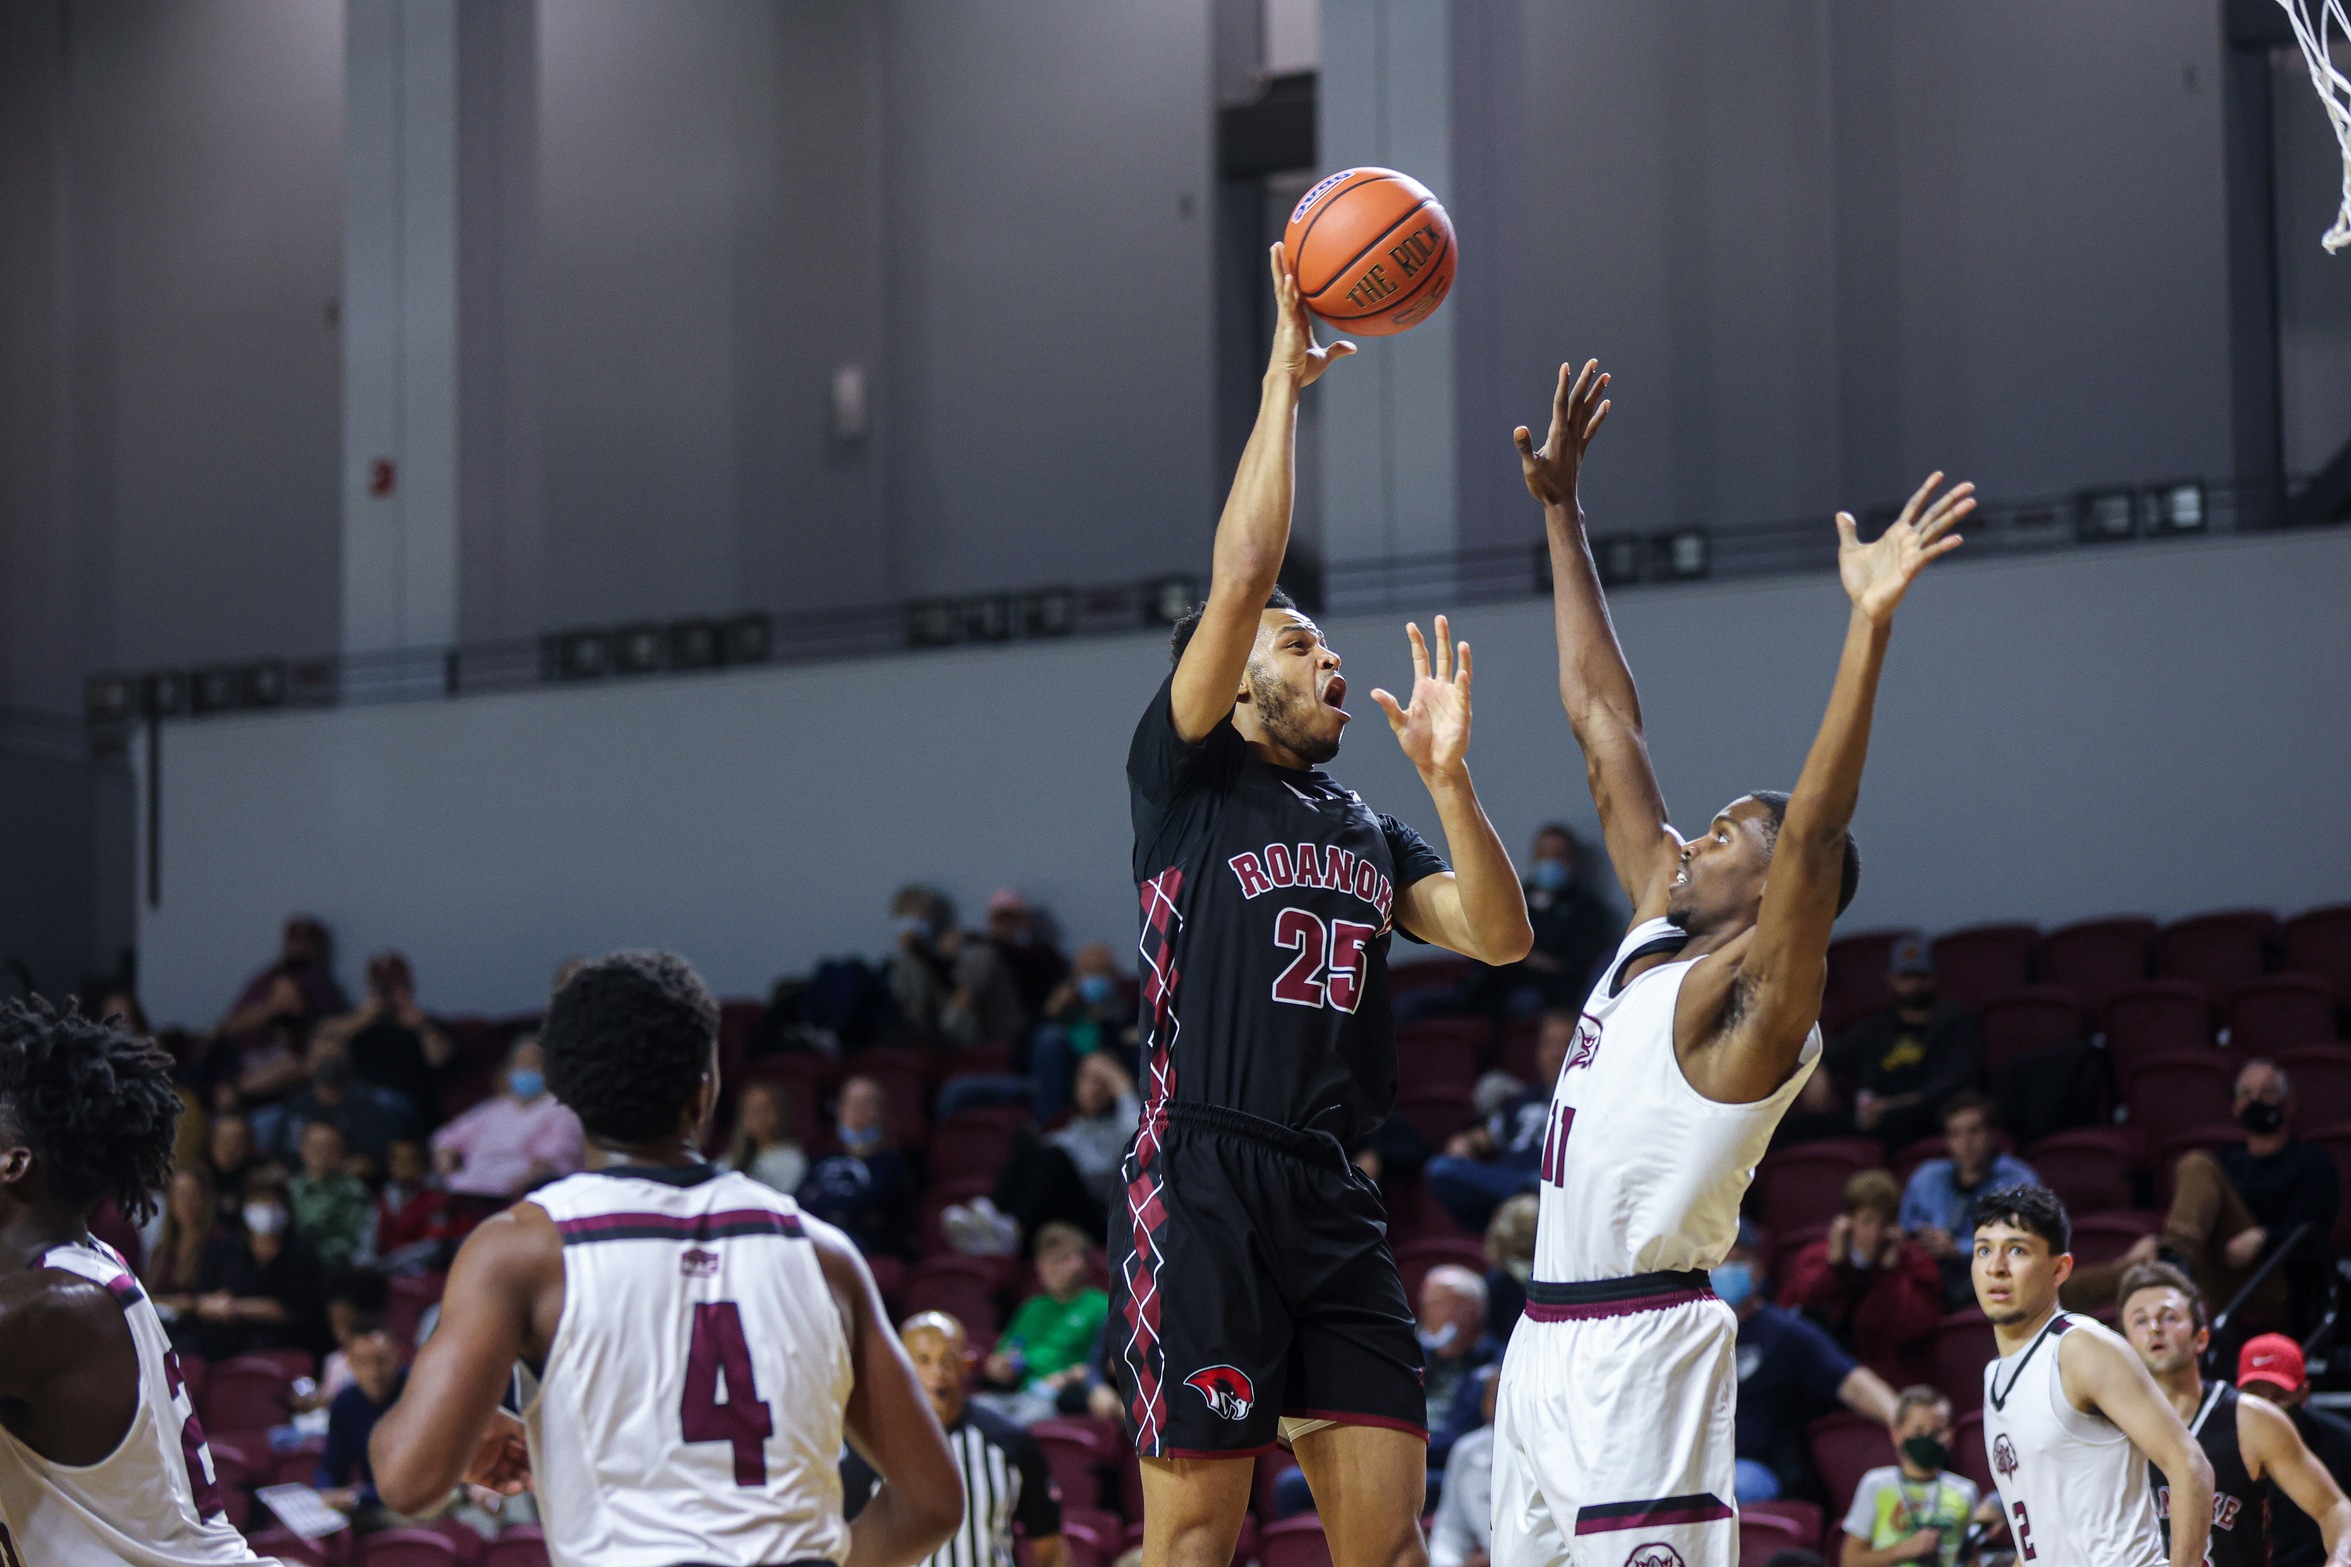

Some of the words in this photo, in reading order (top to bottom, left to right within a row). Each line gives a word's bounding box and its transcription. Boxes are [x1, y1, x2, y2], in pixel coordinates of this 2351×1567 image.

[1346, 263, 1400, 308] THE
[1388, 223, 1441, 280] ROCK
[1272, 907, 1377, 1015] 25
[680, 1301, 773, 1487] 4
[2012, 1500, 2037, 1562] 2
